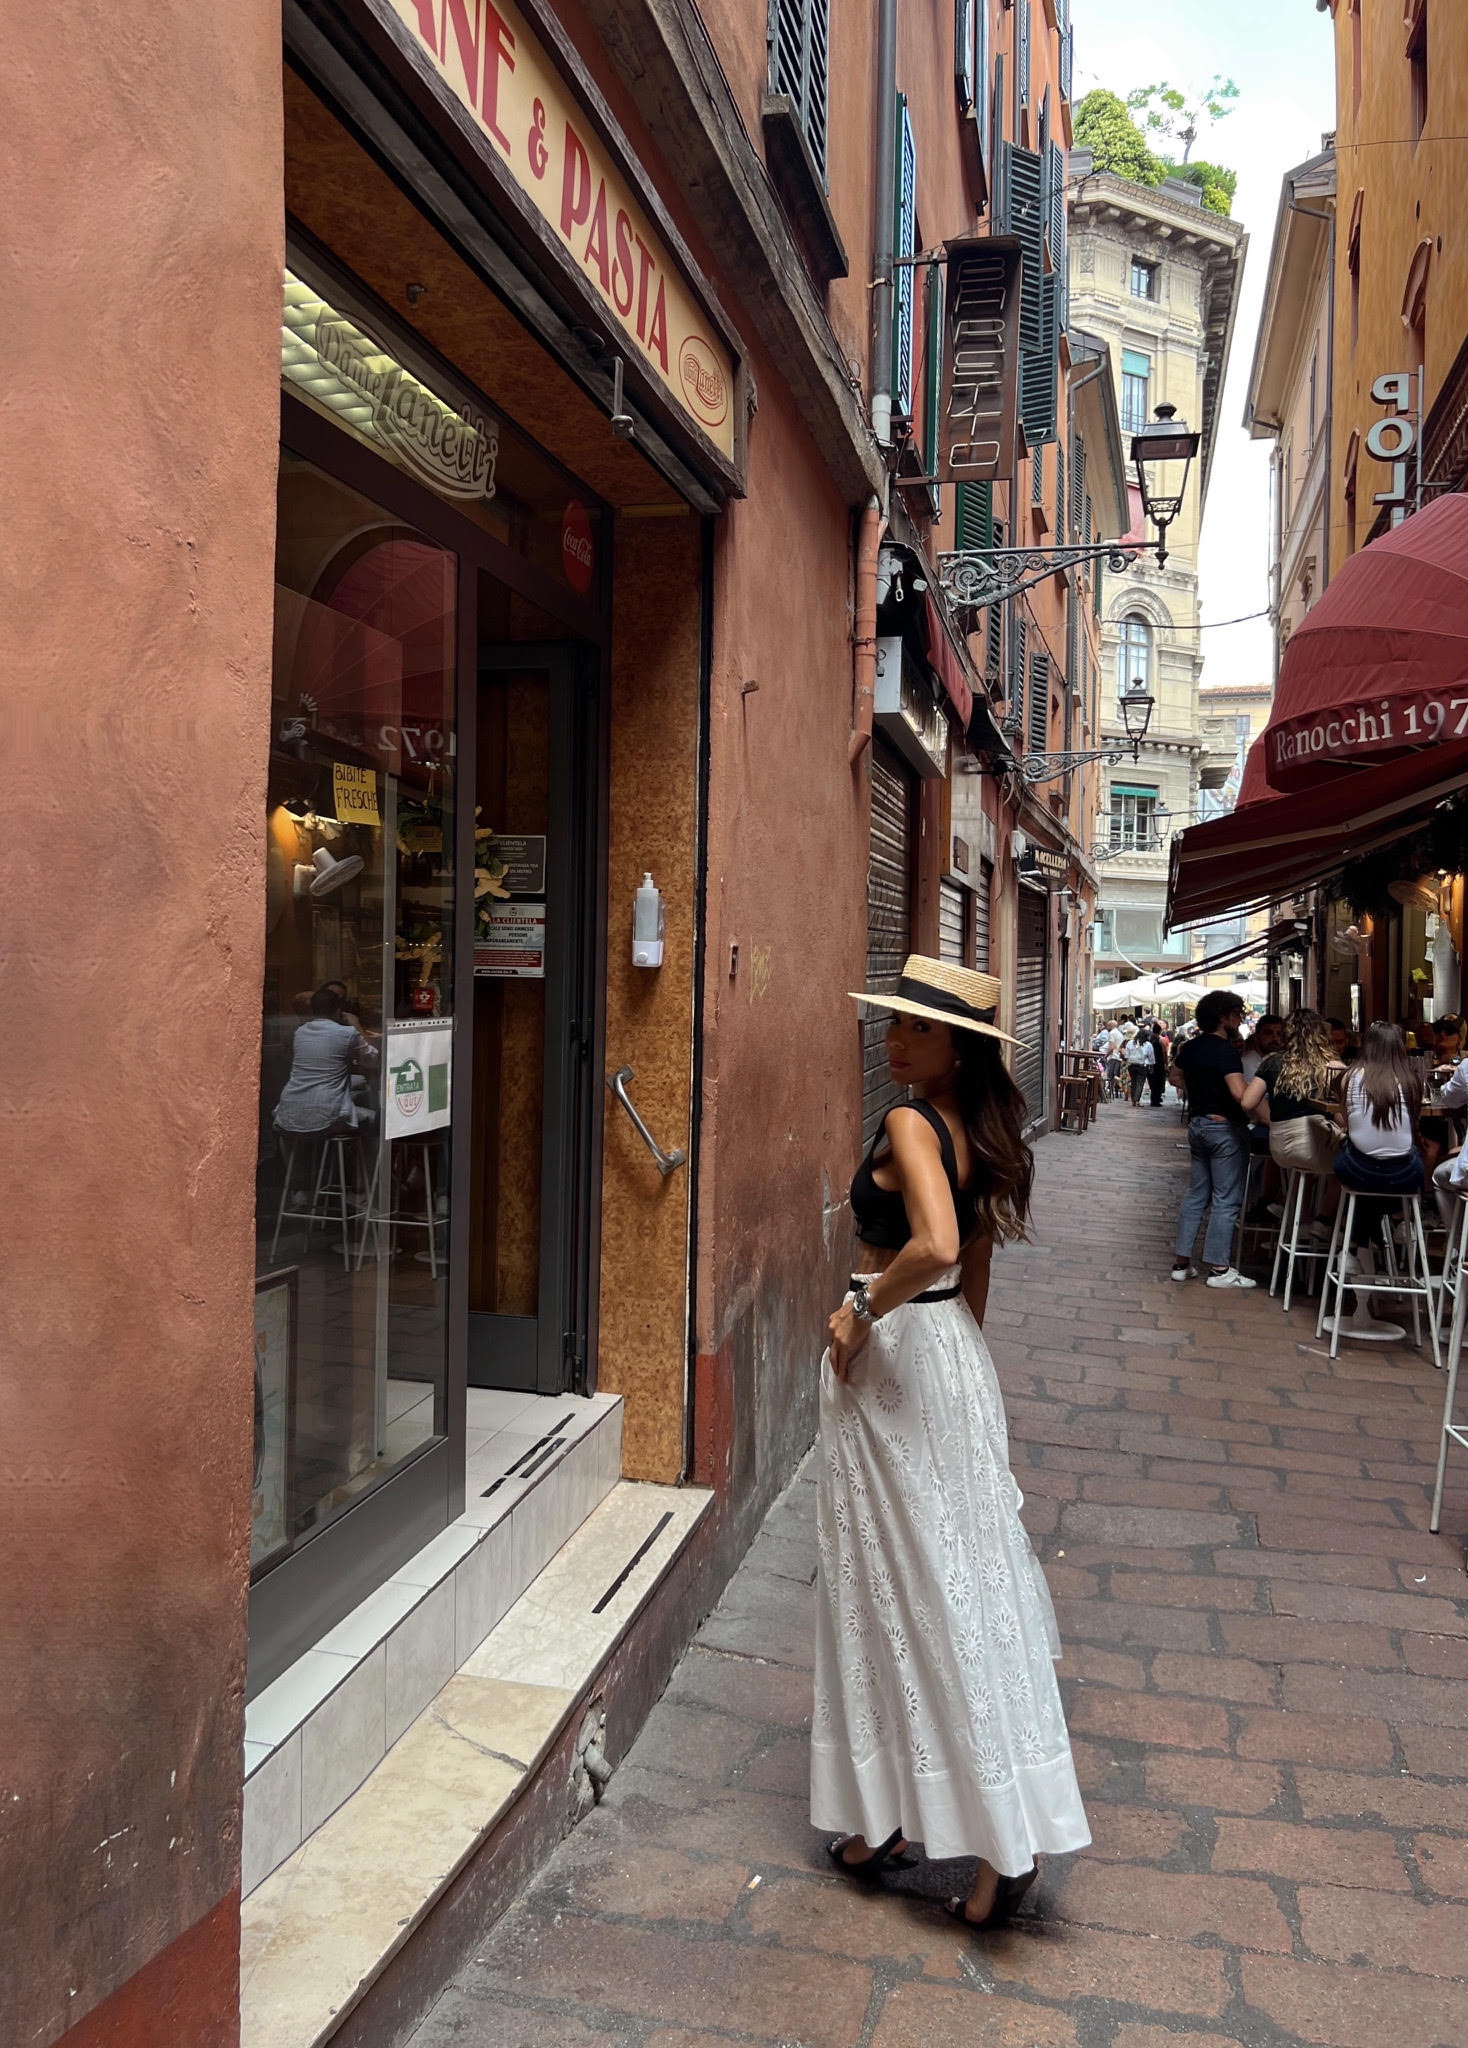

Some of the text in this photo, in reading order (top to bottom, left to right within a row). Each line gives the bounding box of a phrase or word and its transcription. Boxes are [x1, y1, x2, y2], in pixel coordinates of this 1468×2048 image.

[528, 97, 549, 180] &
[560, 120, 669, 376] PASTA
[1275, 701, 1394, 763] Ranocchi
[335, 764, 367, 784] BIBITE
[336, 786, 379, 811] FRESCHE
